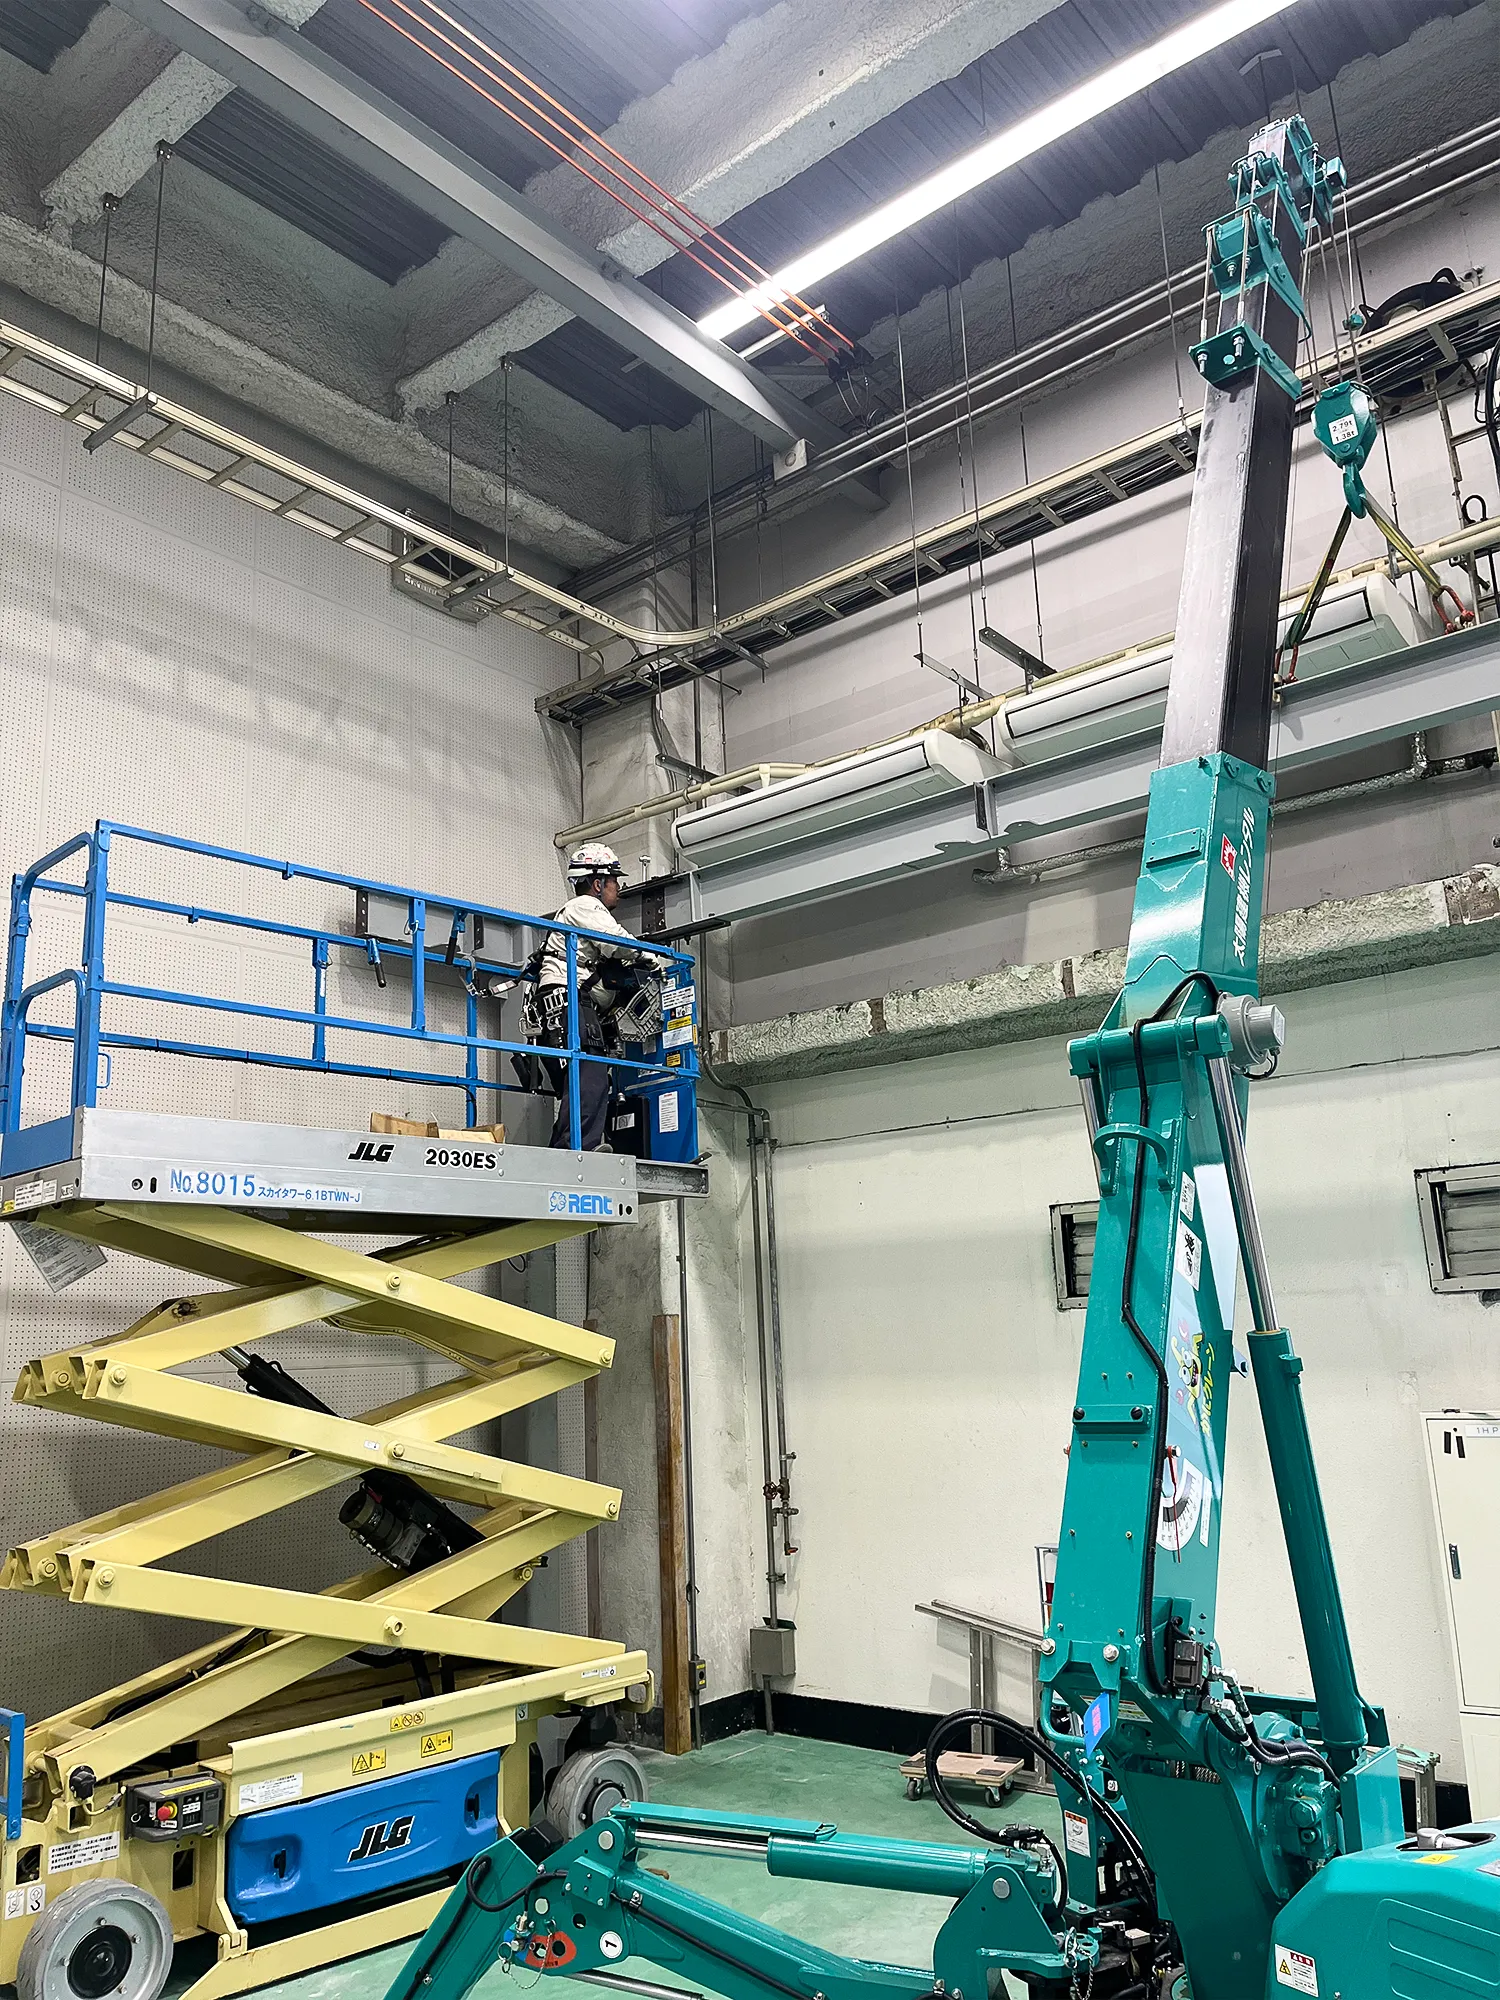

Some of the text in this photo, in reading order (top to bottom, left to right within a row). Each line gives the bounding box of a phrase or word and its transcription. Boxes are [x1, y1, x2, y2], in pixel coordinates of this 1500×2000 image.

[1233, 806, 1255, 967] 太陽建機レンタル
[348, 1142, 497, 1169] JLG 2030ES
[1200, 1342, 1215, 1438] かにクレーン
[347, 1816, 415, 1863] JLG
